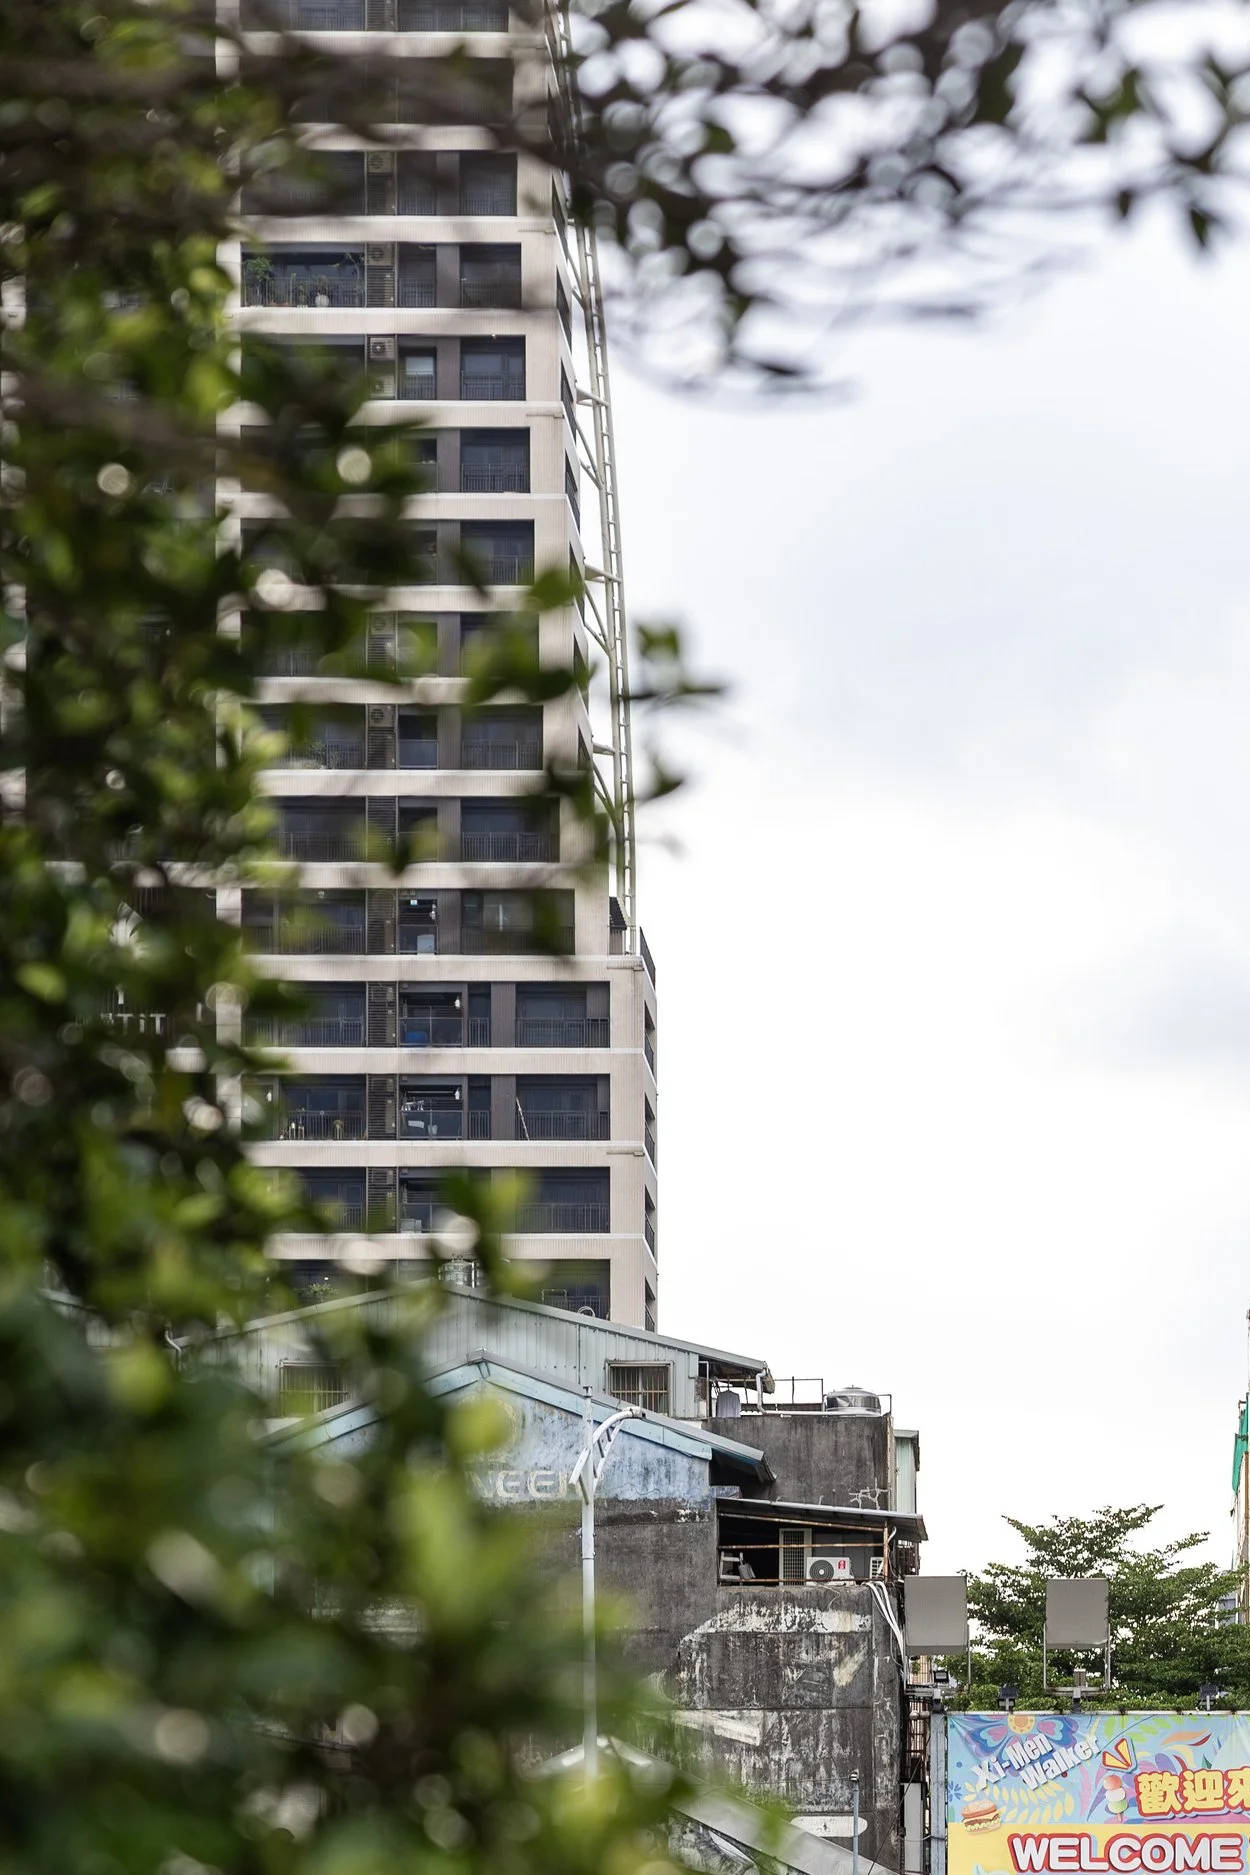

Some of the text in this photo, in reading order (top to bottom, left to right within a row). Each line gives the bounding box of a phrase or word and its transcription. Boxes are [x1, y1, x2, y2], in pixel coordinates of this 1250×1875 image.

[971, 1732, 1055, 1790] Xi-Men
[1019, 1735, 1102, 1791] Walker
[1009, 1834, 1242, 1873] WELCOME
